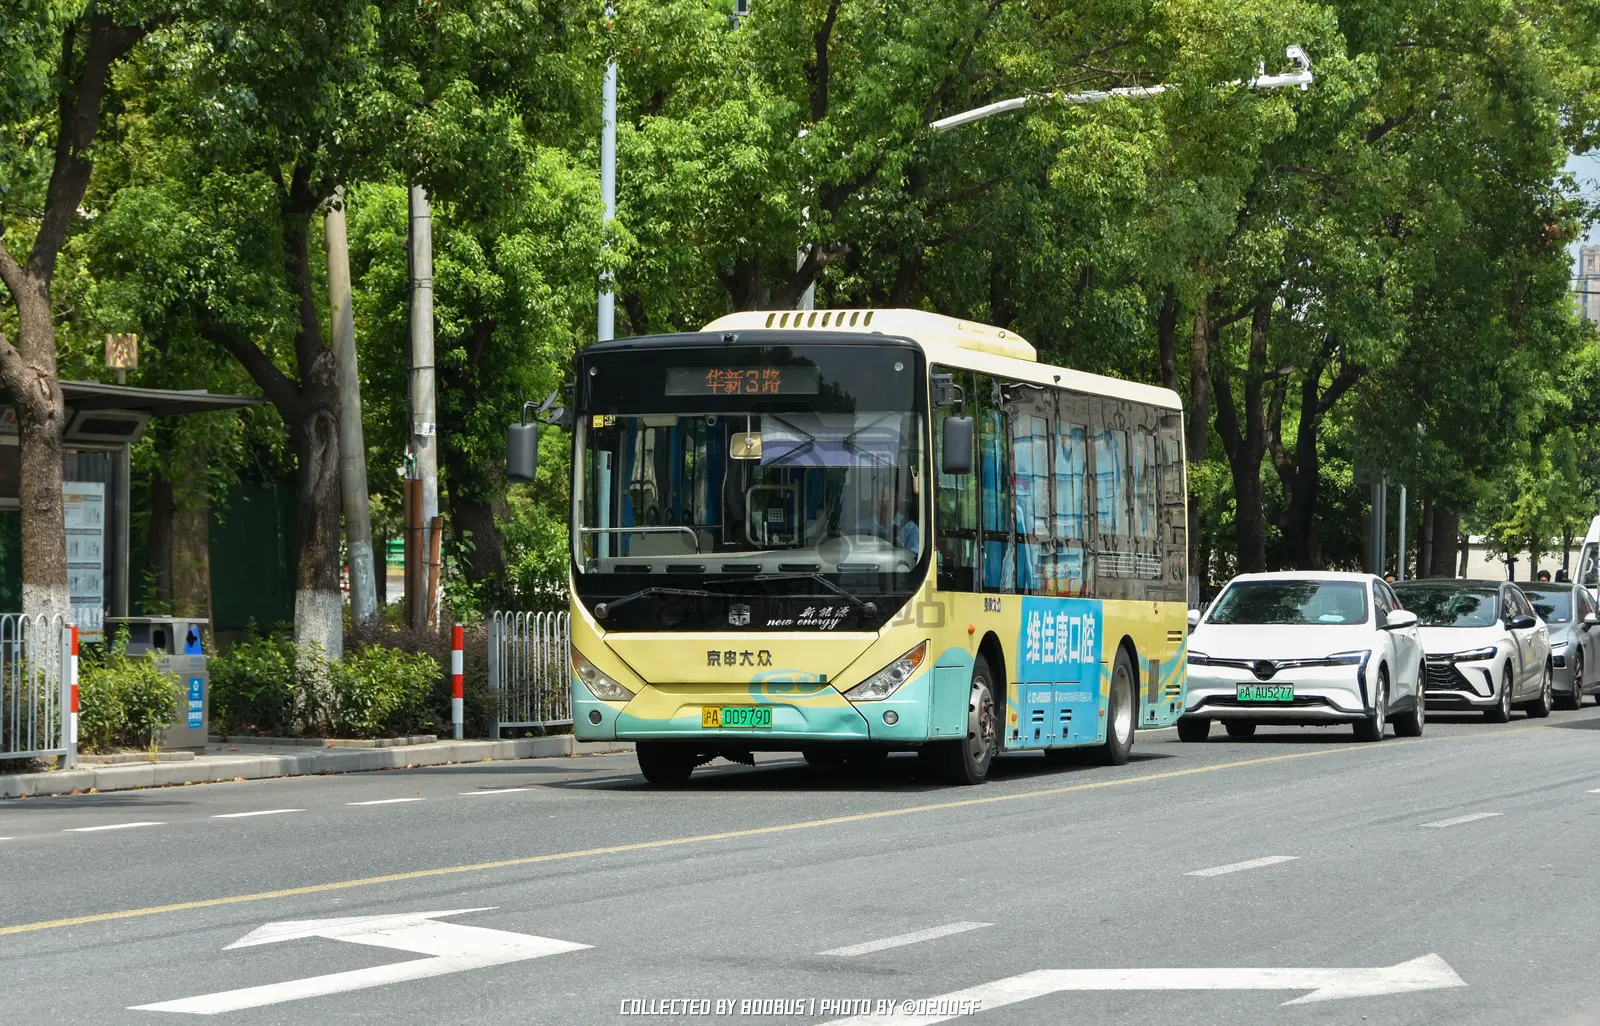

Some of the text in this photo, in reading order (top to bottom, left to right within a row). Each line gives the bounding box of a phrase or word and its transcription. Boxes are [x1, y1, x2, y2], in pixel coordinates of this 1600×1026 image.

[705, 368, 781, 394] 华新3路
[799, 606, 850, 618] 新能源
[766, 615, 842, 630] new energy
[1026, 611, 1096, 665] 维佳康口腔
[707, 650, 772, 666] 京申大众
[1256, 686, 1292, 699] AU5277
[703, 709, 719, 724] 沪A
